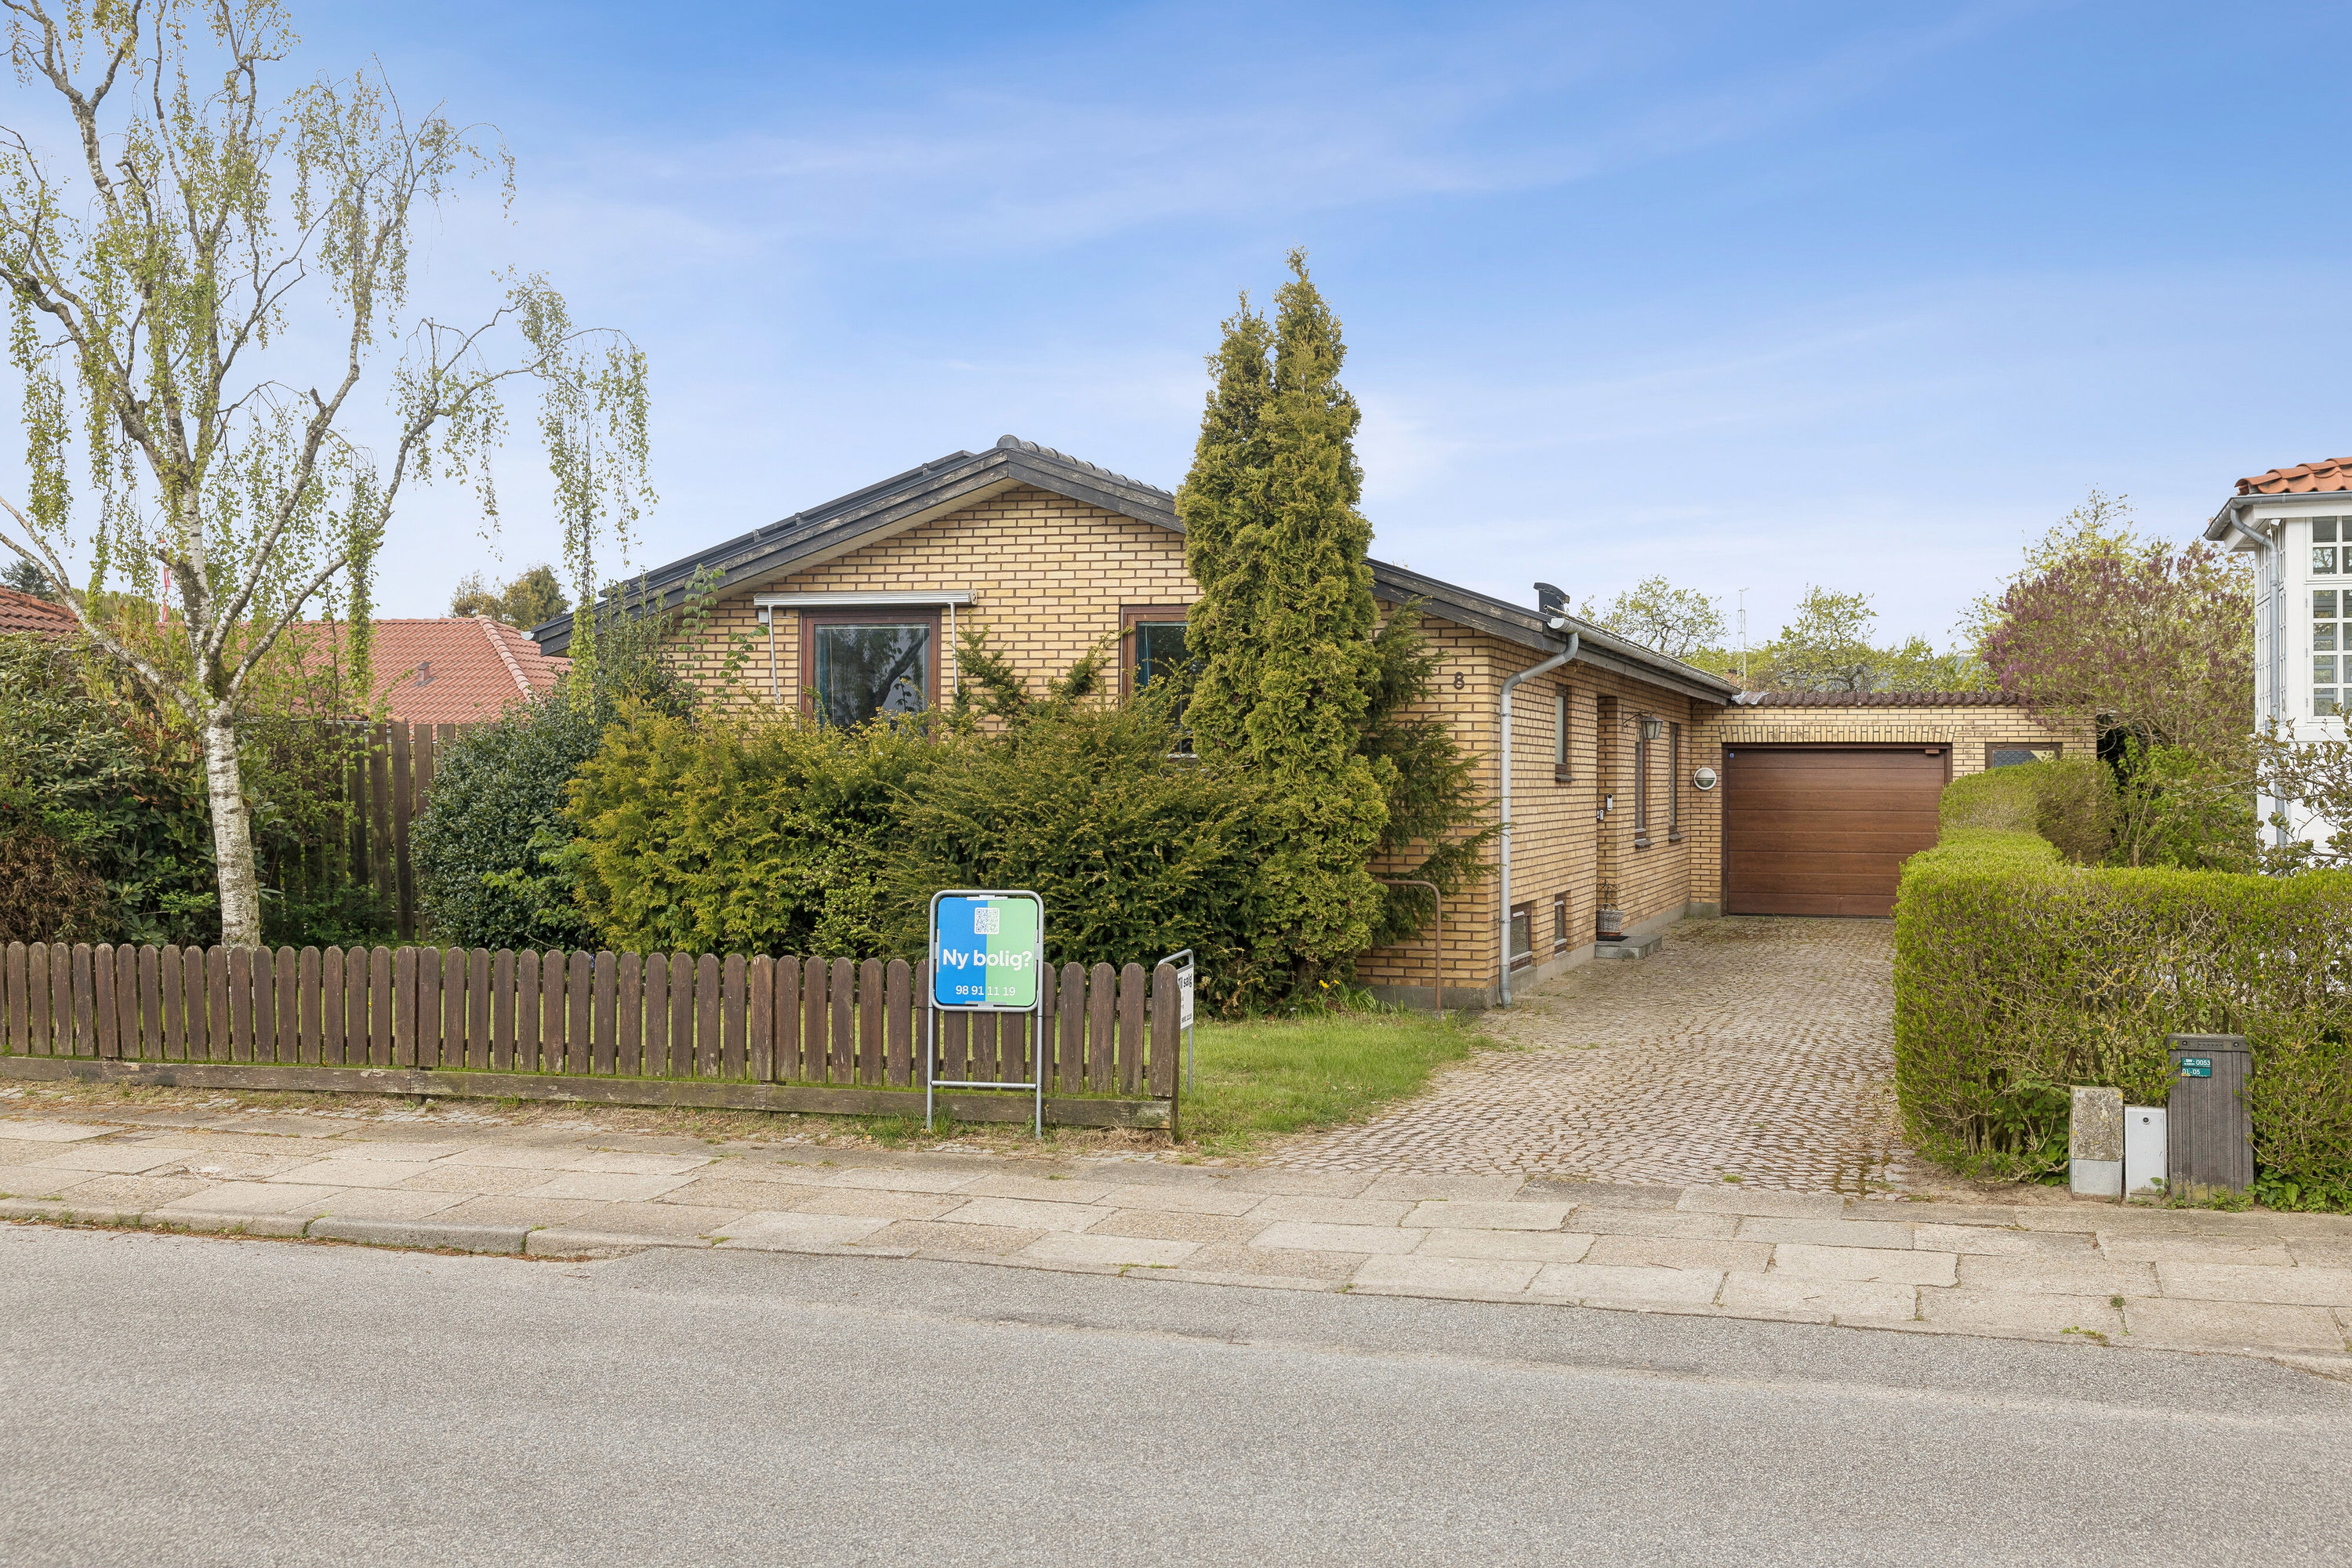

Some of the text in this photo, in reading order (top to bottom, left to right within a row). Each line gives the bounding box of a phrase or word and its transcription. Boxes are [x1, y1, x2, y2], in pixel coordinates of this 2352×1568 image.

[1454, 672, 1465, 690] 8
[942, 949, 1033, 971] Ny bolig?
[1184, 973, 1192, 988] salg
[955, 985, 1016, 996] 98 91 11 19
